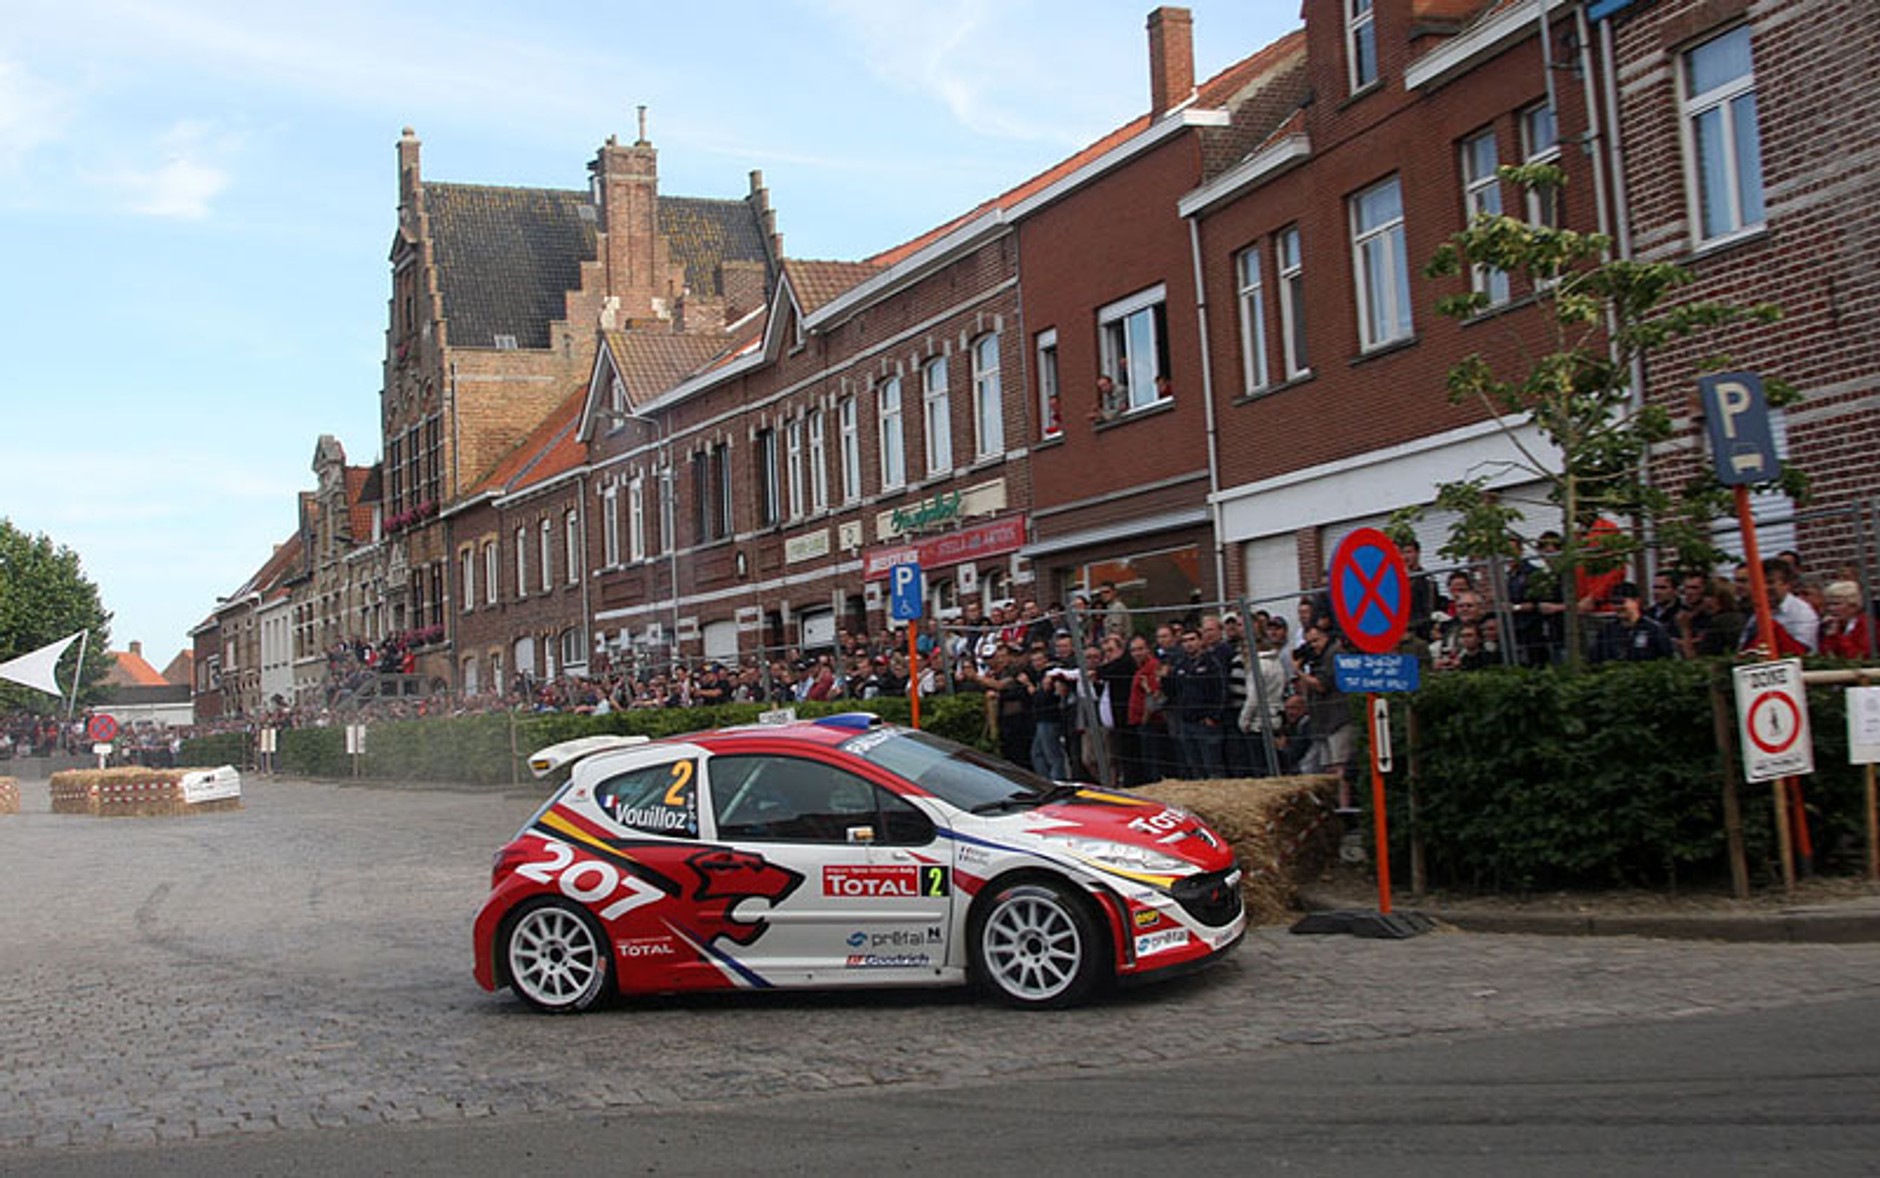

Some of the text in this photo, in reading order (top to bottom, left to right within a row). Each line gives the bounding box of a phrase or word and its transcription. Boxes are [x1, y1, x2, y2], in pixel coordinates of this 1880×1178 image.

[1715, 383, 1751, 438] P
[896, 567, 912, 596] P
[664, 759, 693, 806] 2
[615, 803, 687, 829] Vouilloz
[515, 842, 667, 921] 207
[827, 868, 942, 896] TOTAL 2
[616, 944, 675, 957] TOTAL
